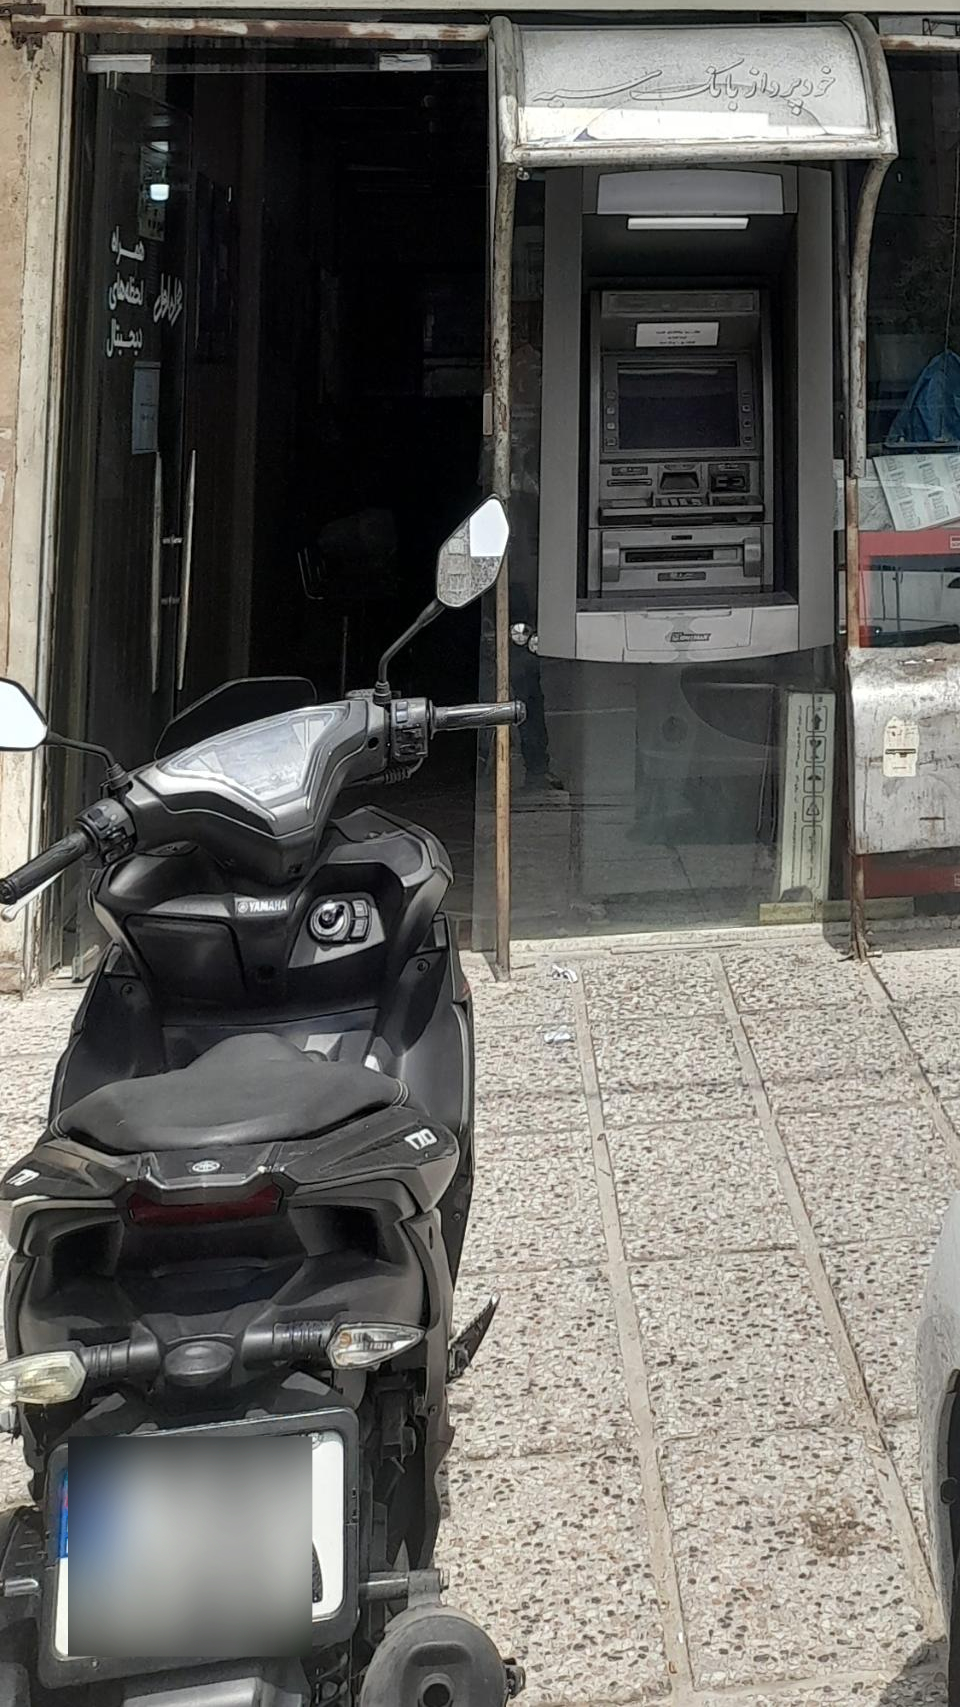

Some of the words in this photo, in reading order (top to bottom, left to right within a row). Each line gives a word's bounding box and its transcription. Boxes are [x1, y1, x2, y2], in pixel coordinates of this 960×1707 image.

[629, 57, 745, 111] بانک
[744, 65, 837, 117] خودپرداز
[106, 318, 144, 358] دیجیتال
[249, 898, 287, 913] YAMAHA
